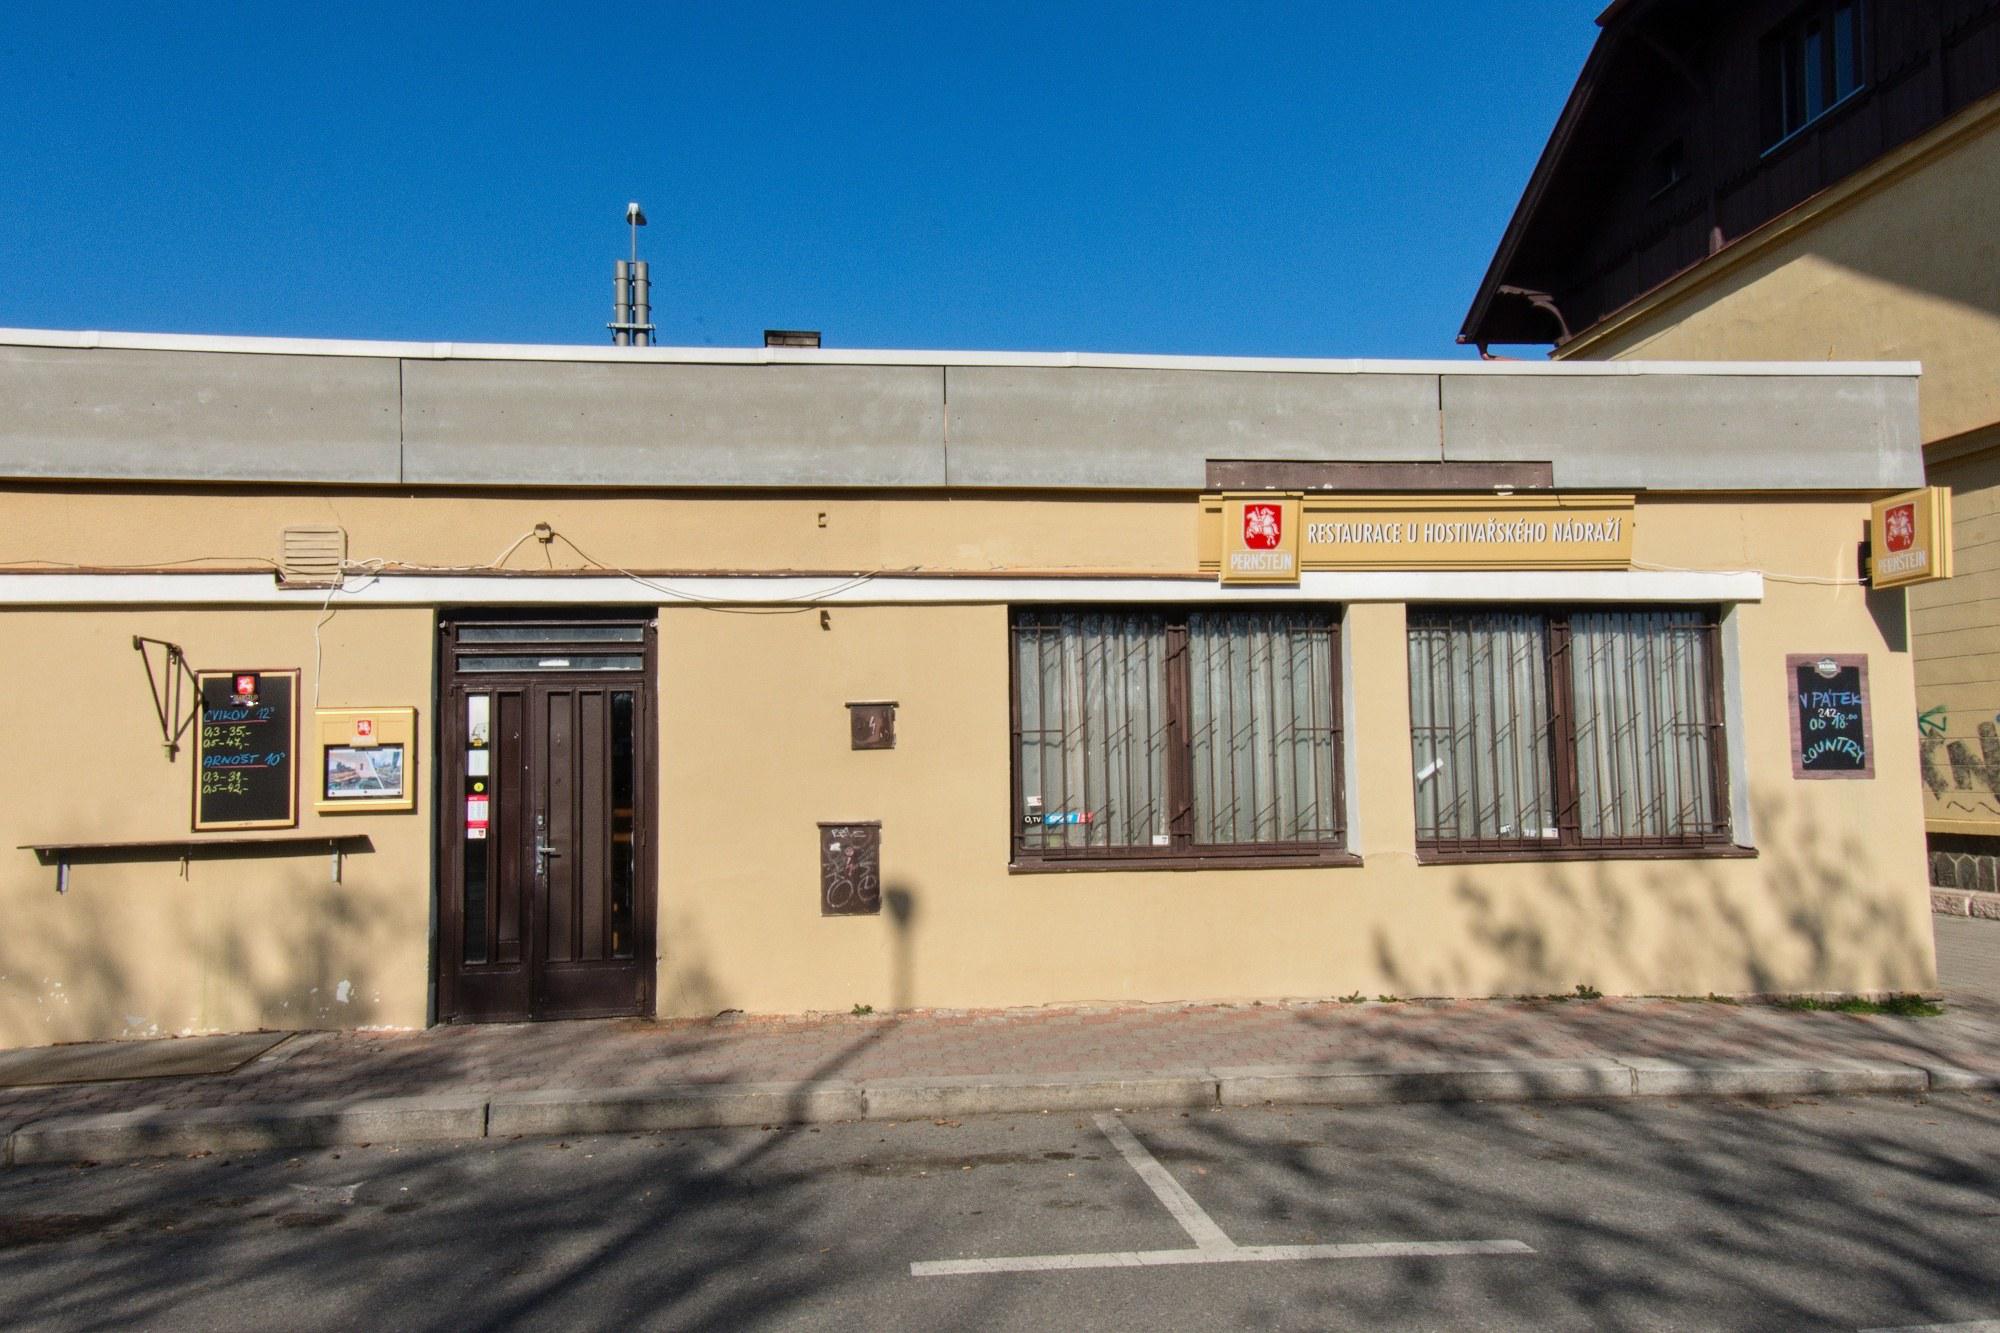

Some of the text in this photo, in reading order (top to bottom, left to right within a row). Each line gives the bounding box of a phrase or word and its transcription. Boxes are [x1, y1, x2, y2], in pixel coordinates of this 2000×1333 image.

[1308, 517, 1622, 543] RESTAURACE U HOSTIVAŘSKÉHO NÁDRAŽÍ
[1231, 551, 1292, 571] PERNŠTEJN
[1812, 689, 1863, 708] PÁTEK
[203, 709, 249, 722] CVIKOV
[1809, 718, 1827, 731] OD
[203, 753, 260, 767] ARNOŠT
[1802, 736, 1866, 765] COUNTRY
